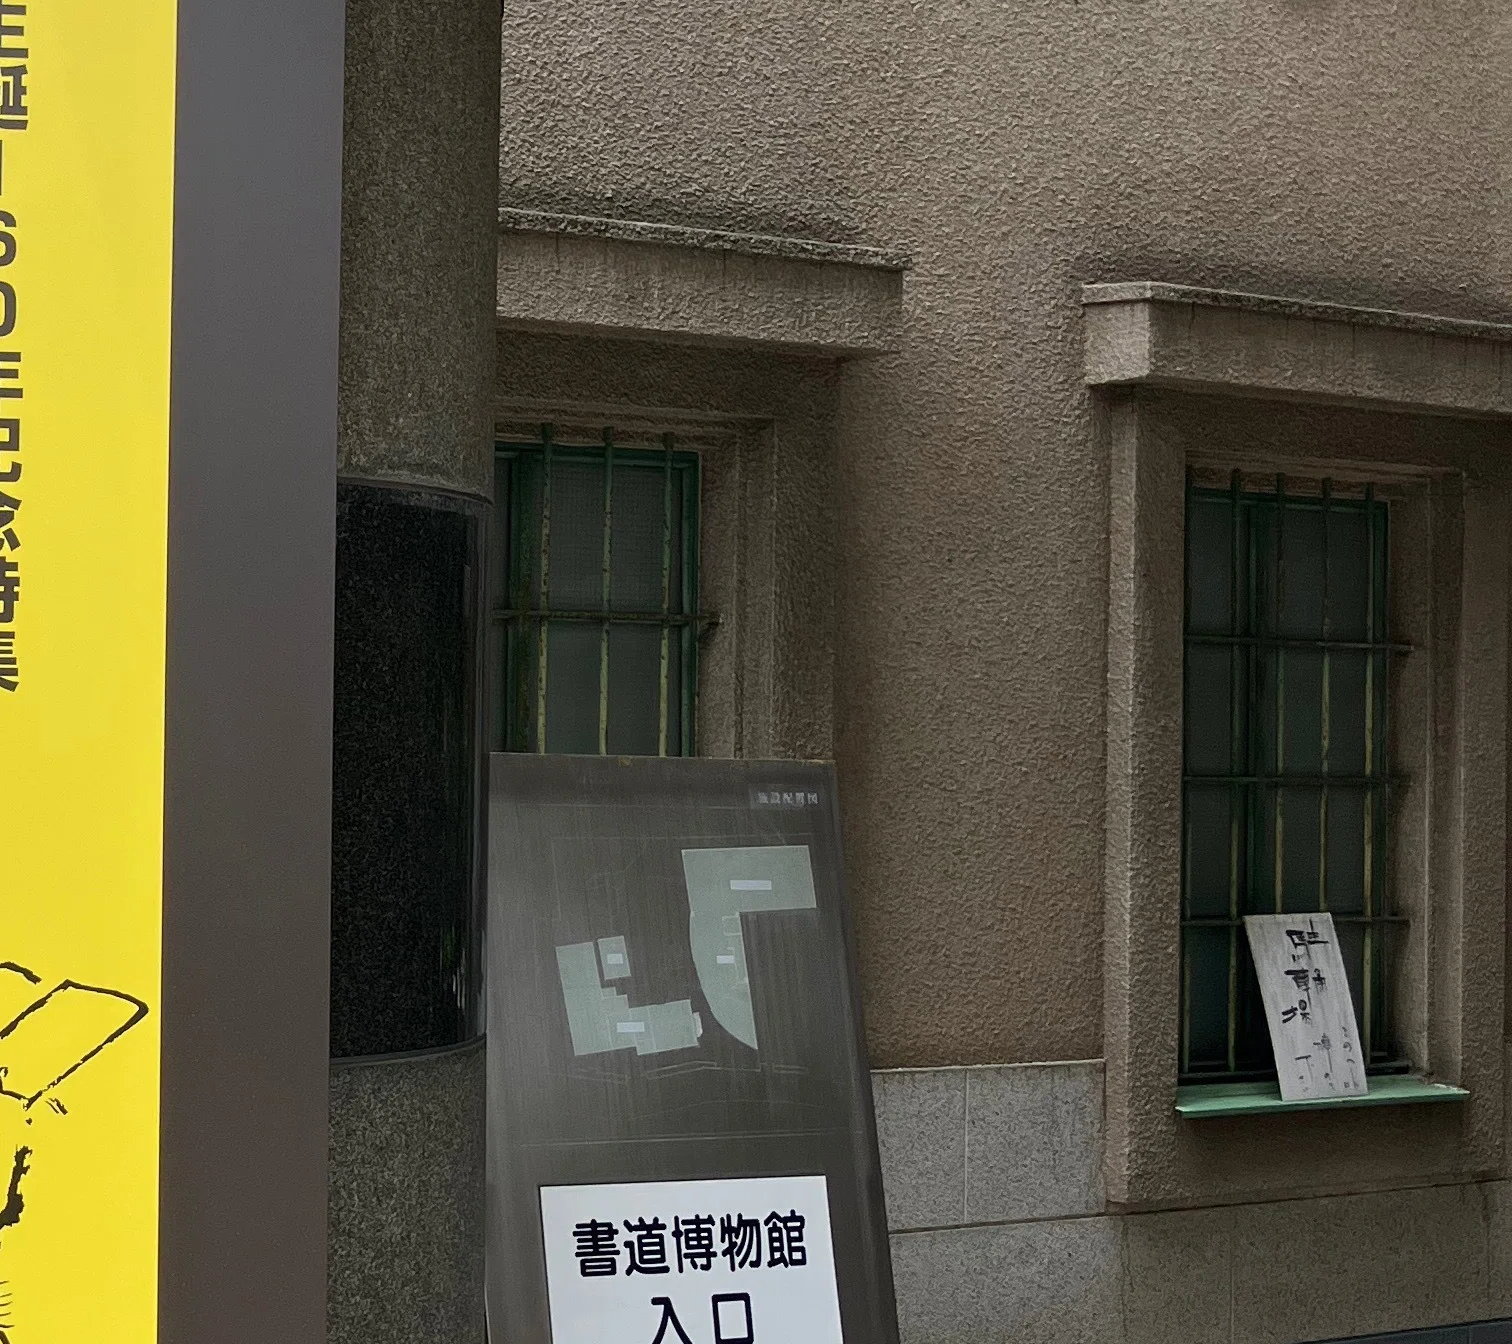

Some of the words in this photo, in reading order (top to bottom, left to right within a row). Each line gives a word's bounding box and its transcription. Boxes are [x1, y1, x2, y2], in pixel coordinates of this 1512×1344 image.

[572, 1209, 808, 1280] 書道博物館
